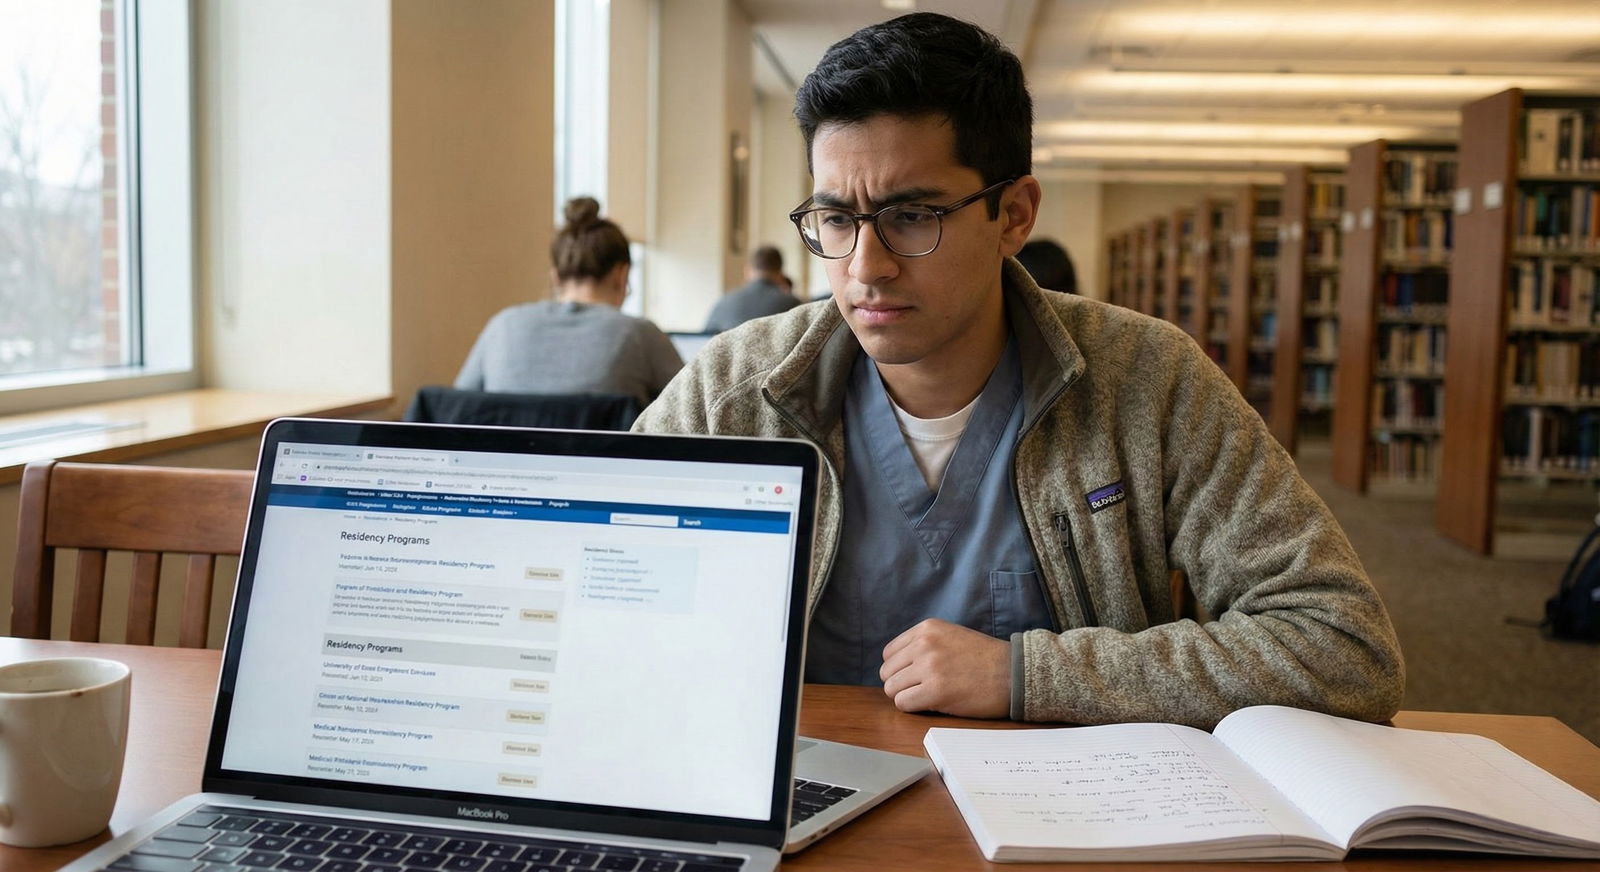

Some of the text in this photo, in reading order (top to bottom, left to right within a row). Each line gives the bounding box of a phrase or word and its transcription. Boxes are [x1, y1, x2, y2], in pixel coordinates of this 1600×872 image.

[341, 531, 430, 546] Residency Programs
[439, 560, 495, 570] Residency Program
[408, 588, 438, 597] Residency
[438, 590, 463, 598] Program
[326, 640, 403, 654] Residency Programs
[405, 699, 434, 708] Residency
[434, 702, 460, 710] Program
[408, 731, 433, 740] Program
[456, 806, 510, 821] MacBook Pro
